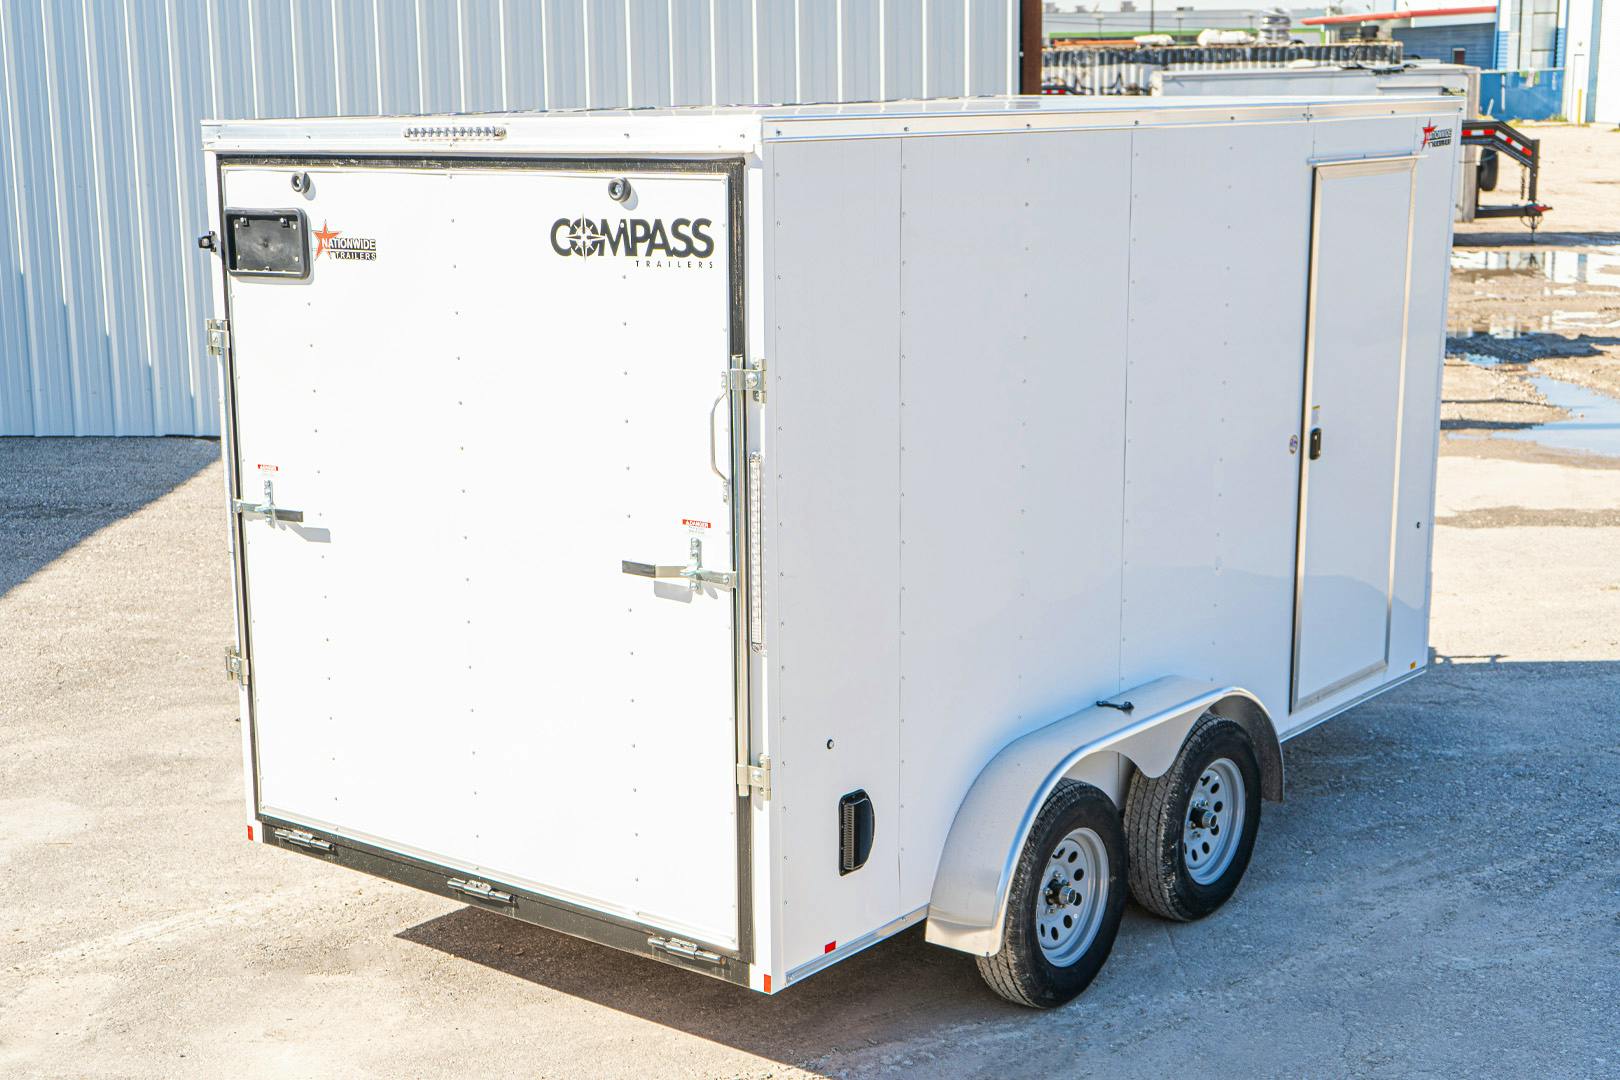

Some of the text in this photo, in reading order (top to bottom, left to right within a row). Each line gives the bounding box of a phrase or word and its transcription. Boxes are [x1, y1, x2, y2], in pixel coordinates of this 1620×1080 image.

[550, 217, 715, 258] COMPASS
[321, 237, 376, 250] NATIONWIDE
[335, 251, 376, 260] TRAILERS
[635, 260, 713, 269] TRAILERS
